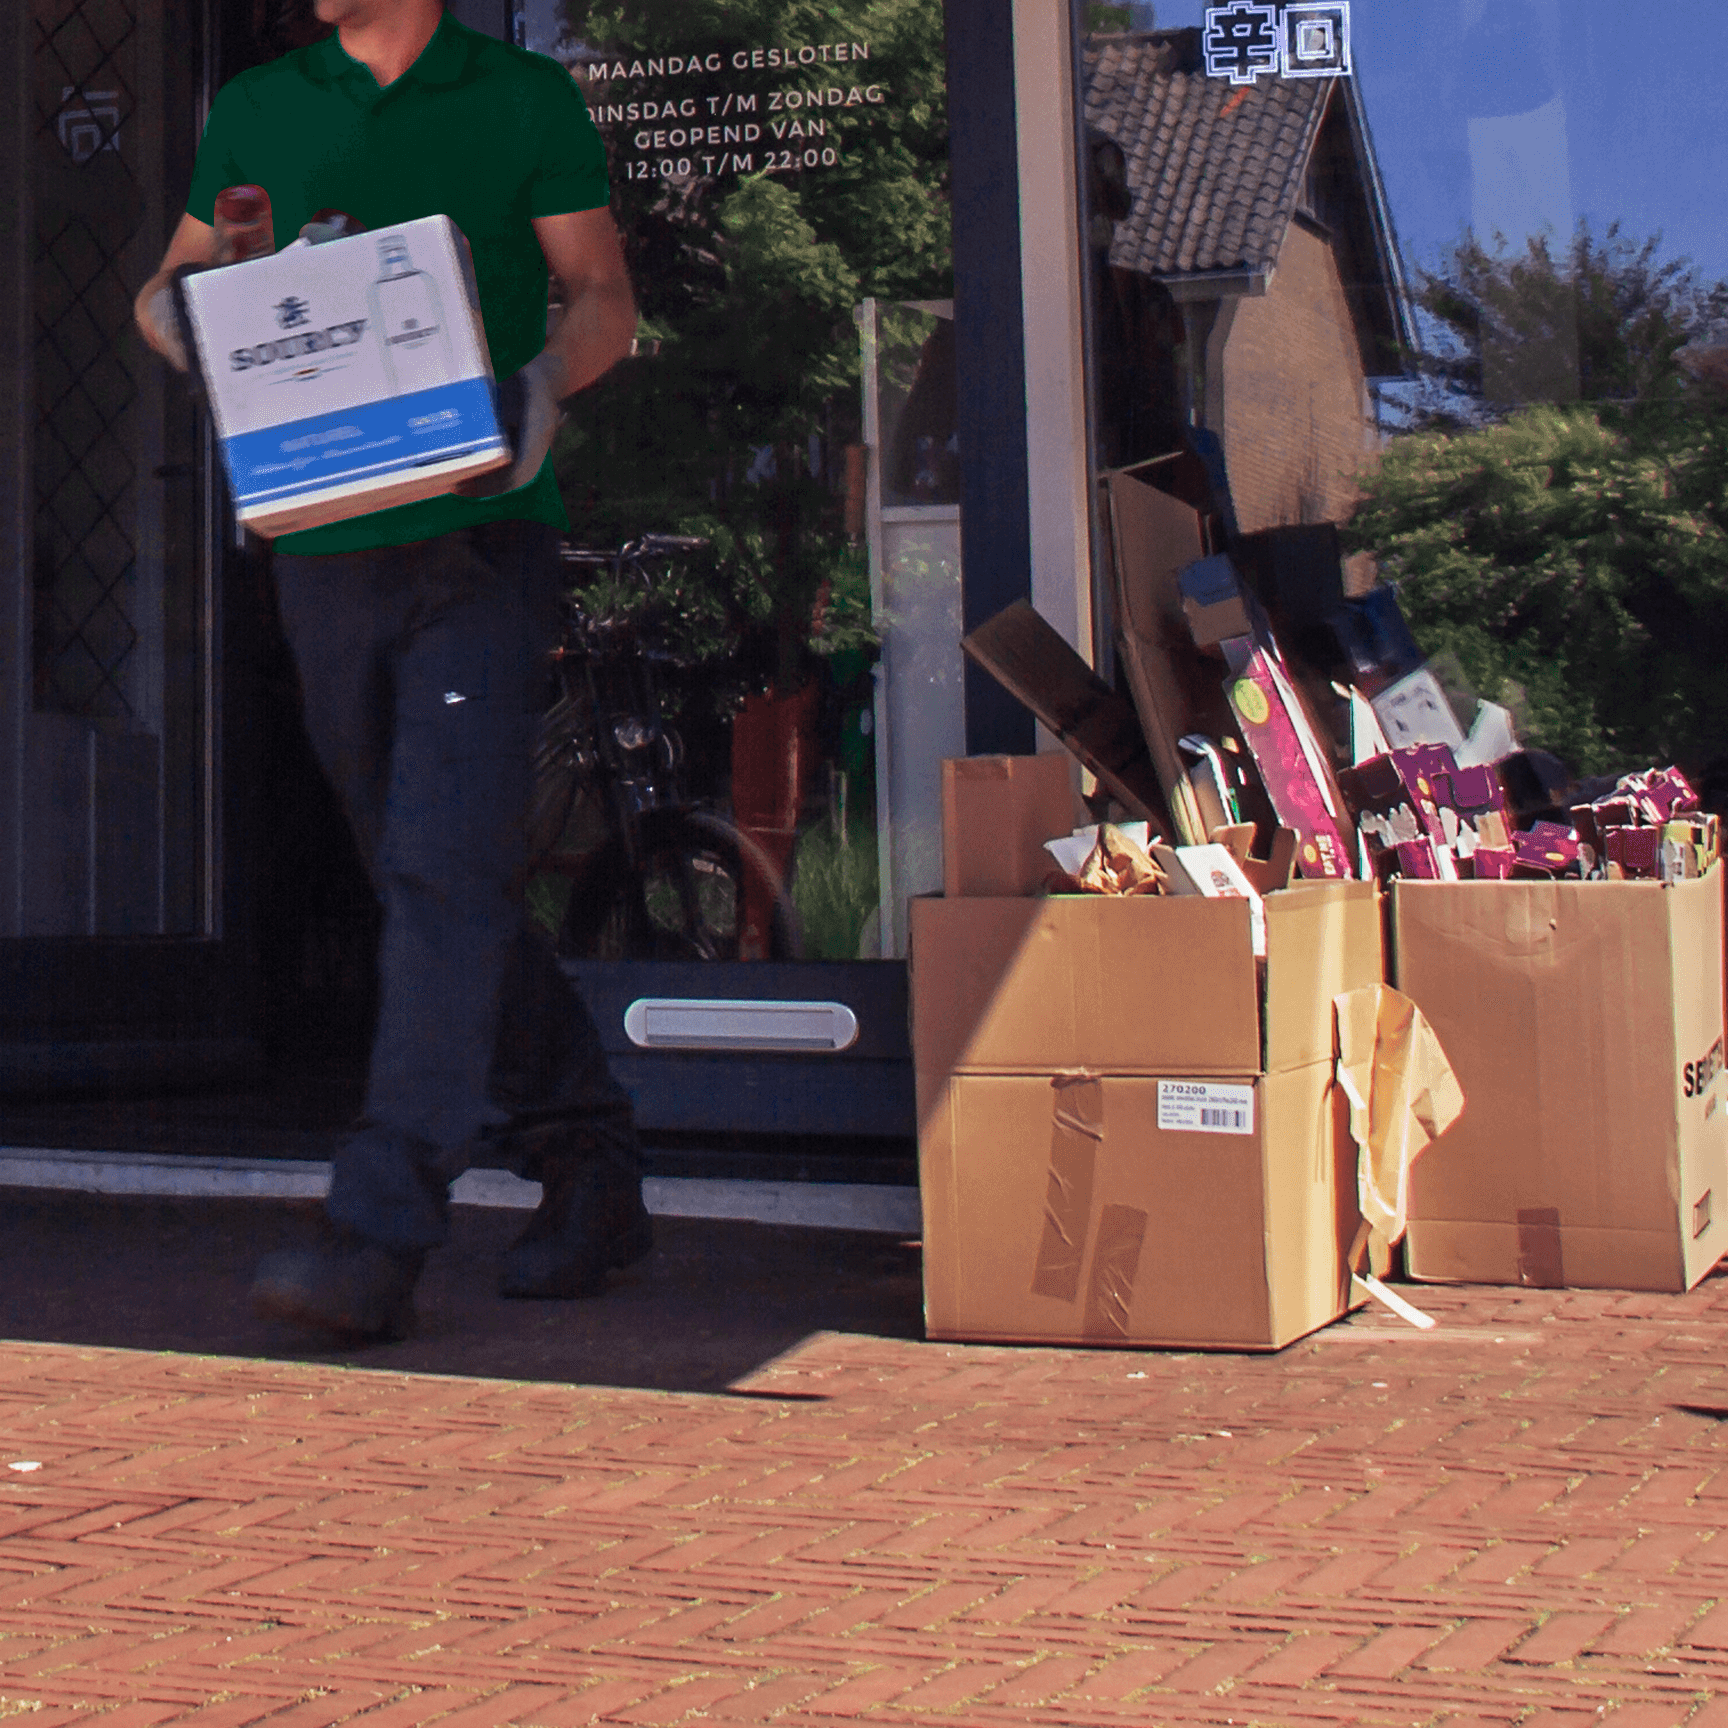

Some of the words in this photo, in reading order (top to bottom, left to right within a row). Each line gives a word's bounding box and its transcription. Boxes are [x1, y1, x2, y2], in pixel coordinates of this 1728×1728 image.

[588, 52, 722, 82] MAANDAG
[732, 41, 871, 70] GESLOTEN
[707, 93, 758, 118] T/M
[767, 84, 886, 112] ZONDAG
[634, 124, 761, 150] GEOPEND
[771, 118, 827, 139] VAN
[625, 158, 692, 180] 12:00
[701, 153, 754, 176] T/M
[763, 147, 838, 171] 22:00
[1163, 1084, 1207, 1095] 270200
